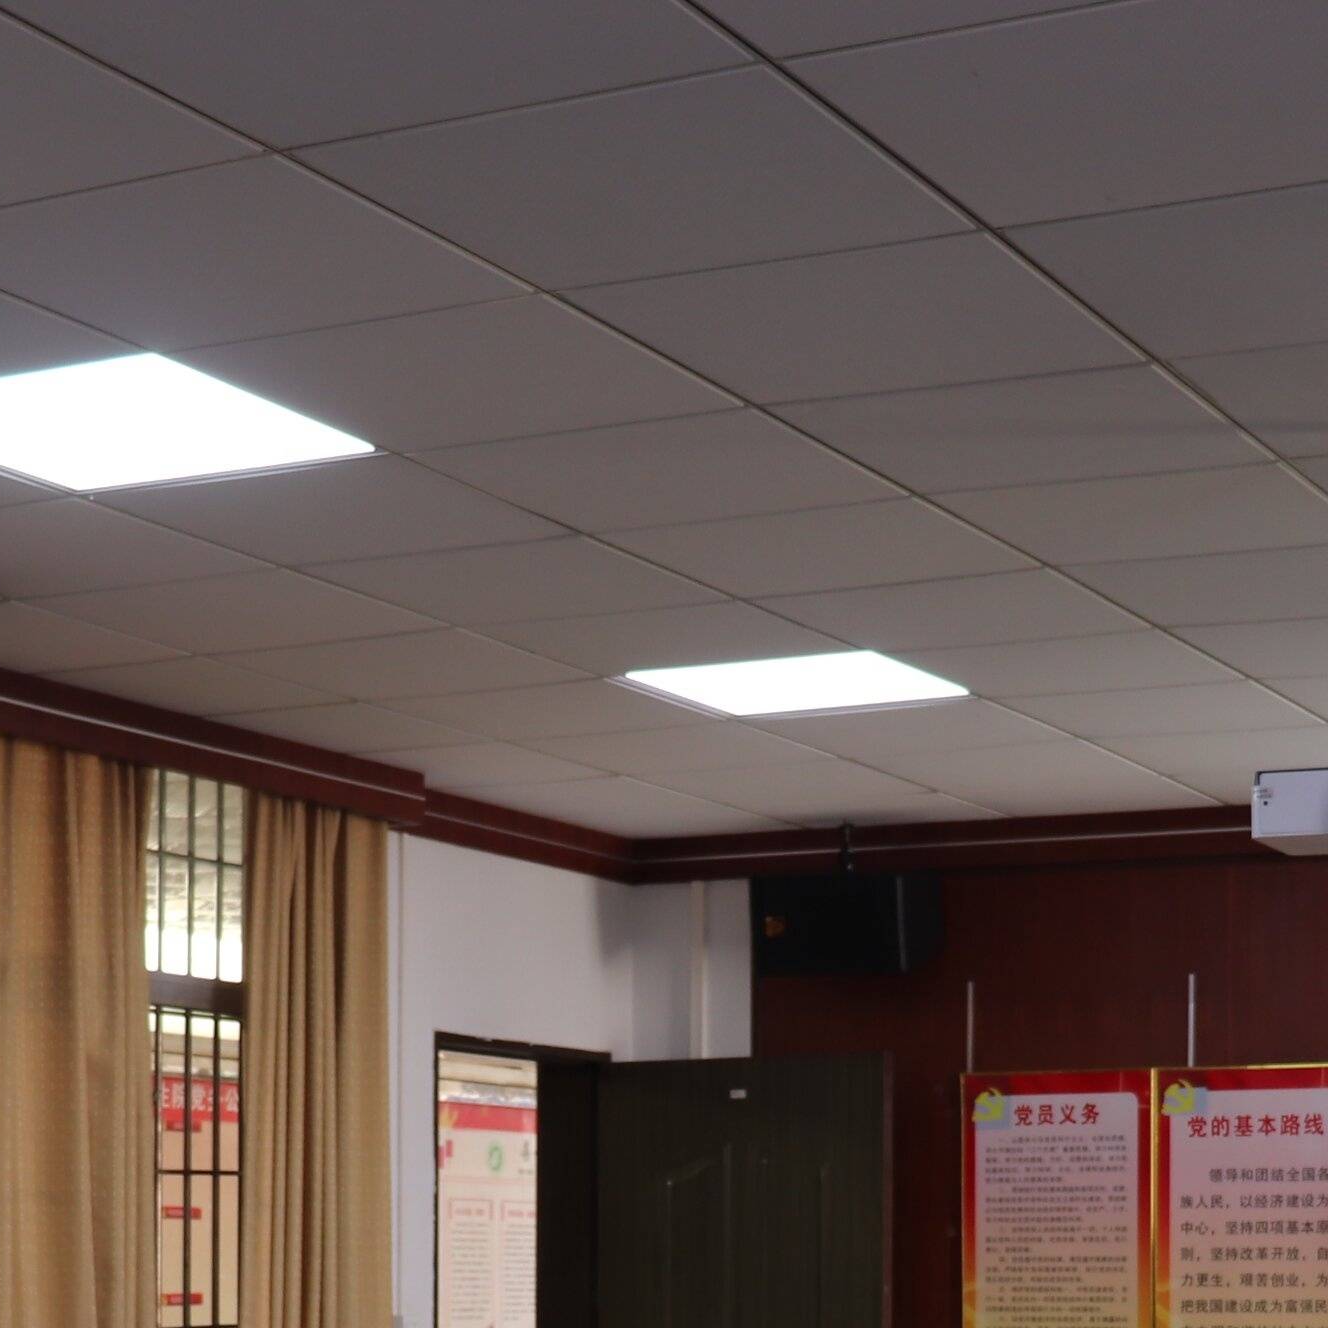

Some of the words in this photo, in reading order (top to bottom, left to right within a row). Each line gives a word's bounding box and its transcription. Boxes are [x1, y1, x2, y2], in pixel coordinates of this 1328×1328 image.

[1013, 1102, 1100, 1127] 党员义务
[1187, 1113, 1325, 1138] 党的基本路线
[1180, 1299, 1328, 1314] 把我国建设成为富强民
